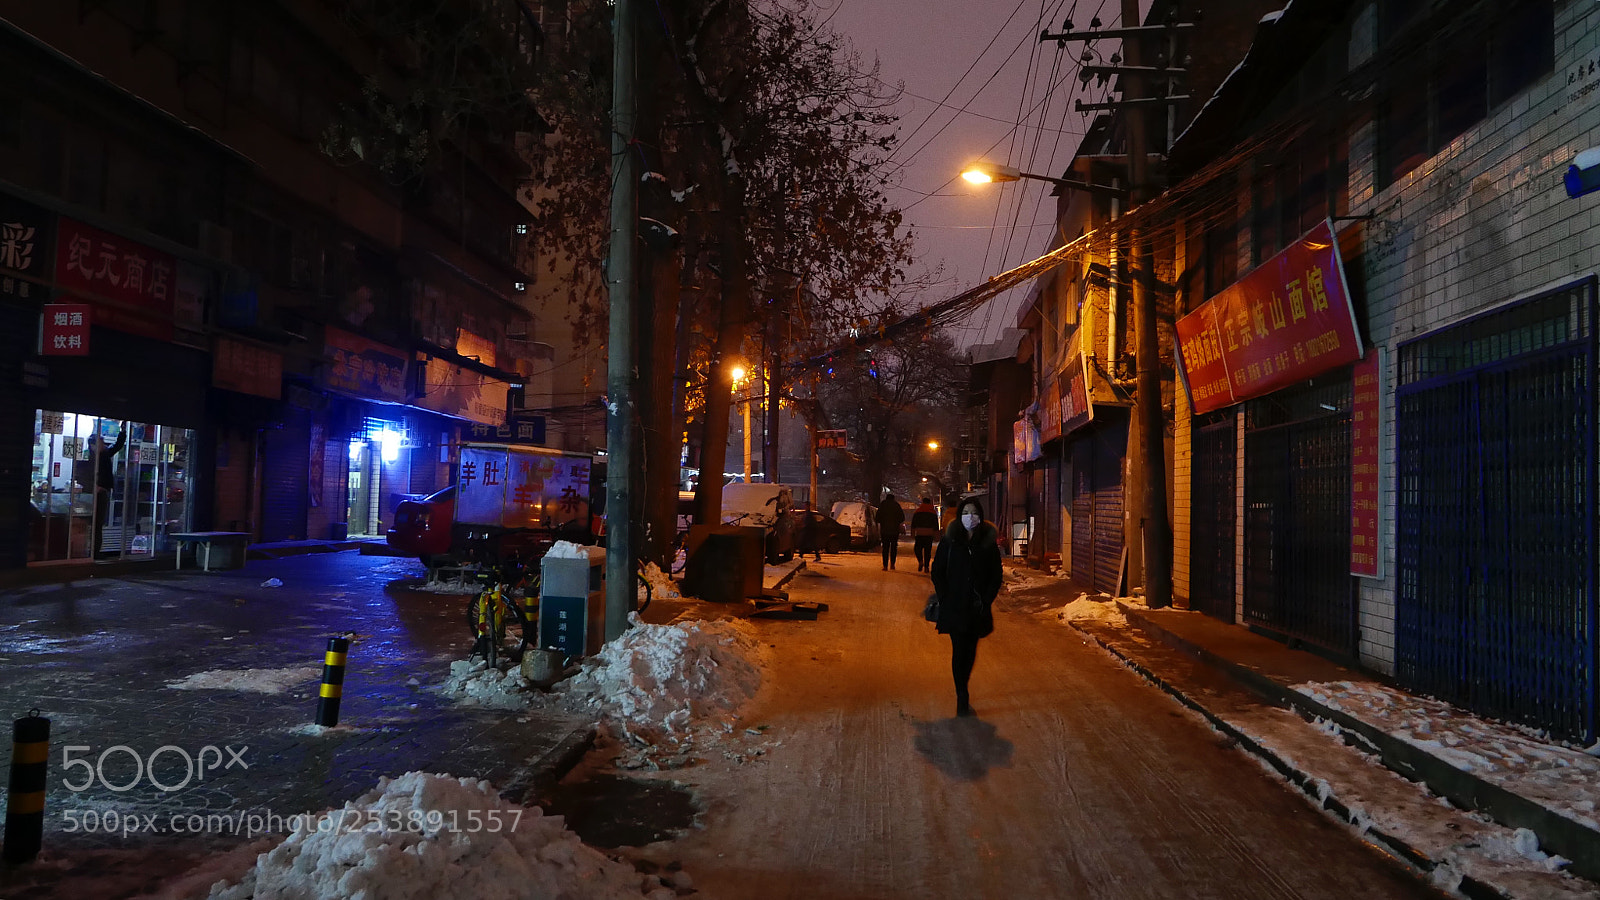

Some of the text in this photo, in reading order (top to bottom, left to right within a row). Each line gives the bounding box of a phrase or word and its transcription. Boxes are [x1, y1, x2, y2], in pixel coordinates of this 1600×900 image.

[0, 222, 36, 270] 彩
[66, 232, 171, 302] 纪元商店
[53, 312, 83, 326] 烟酒
[1223, 265, 1330, 353] 正宗岐山面馆
[53, 334, 82, 350] 饮料
[461, 461, 500, 486] 羊肚
